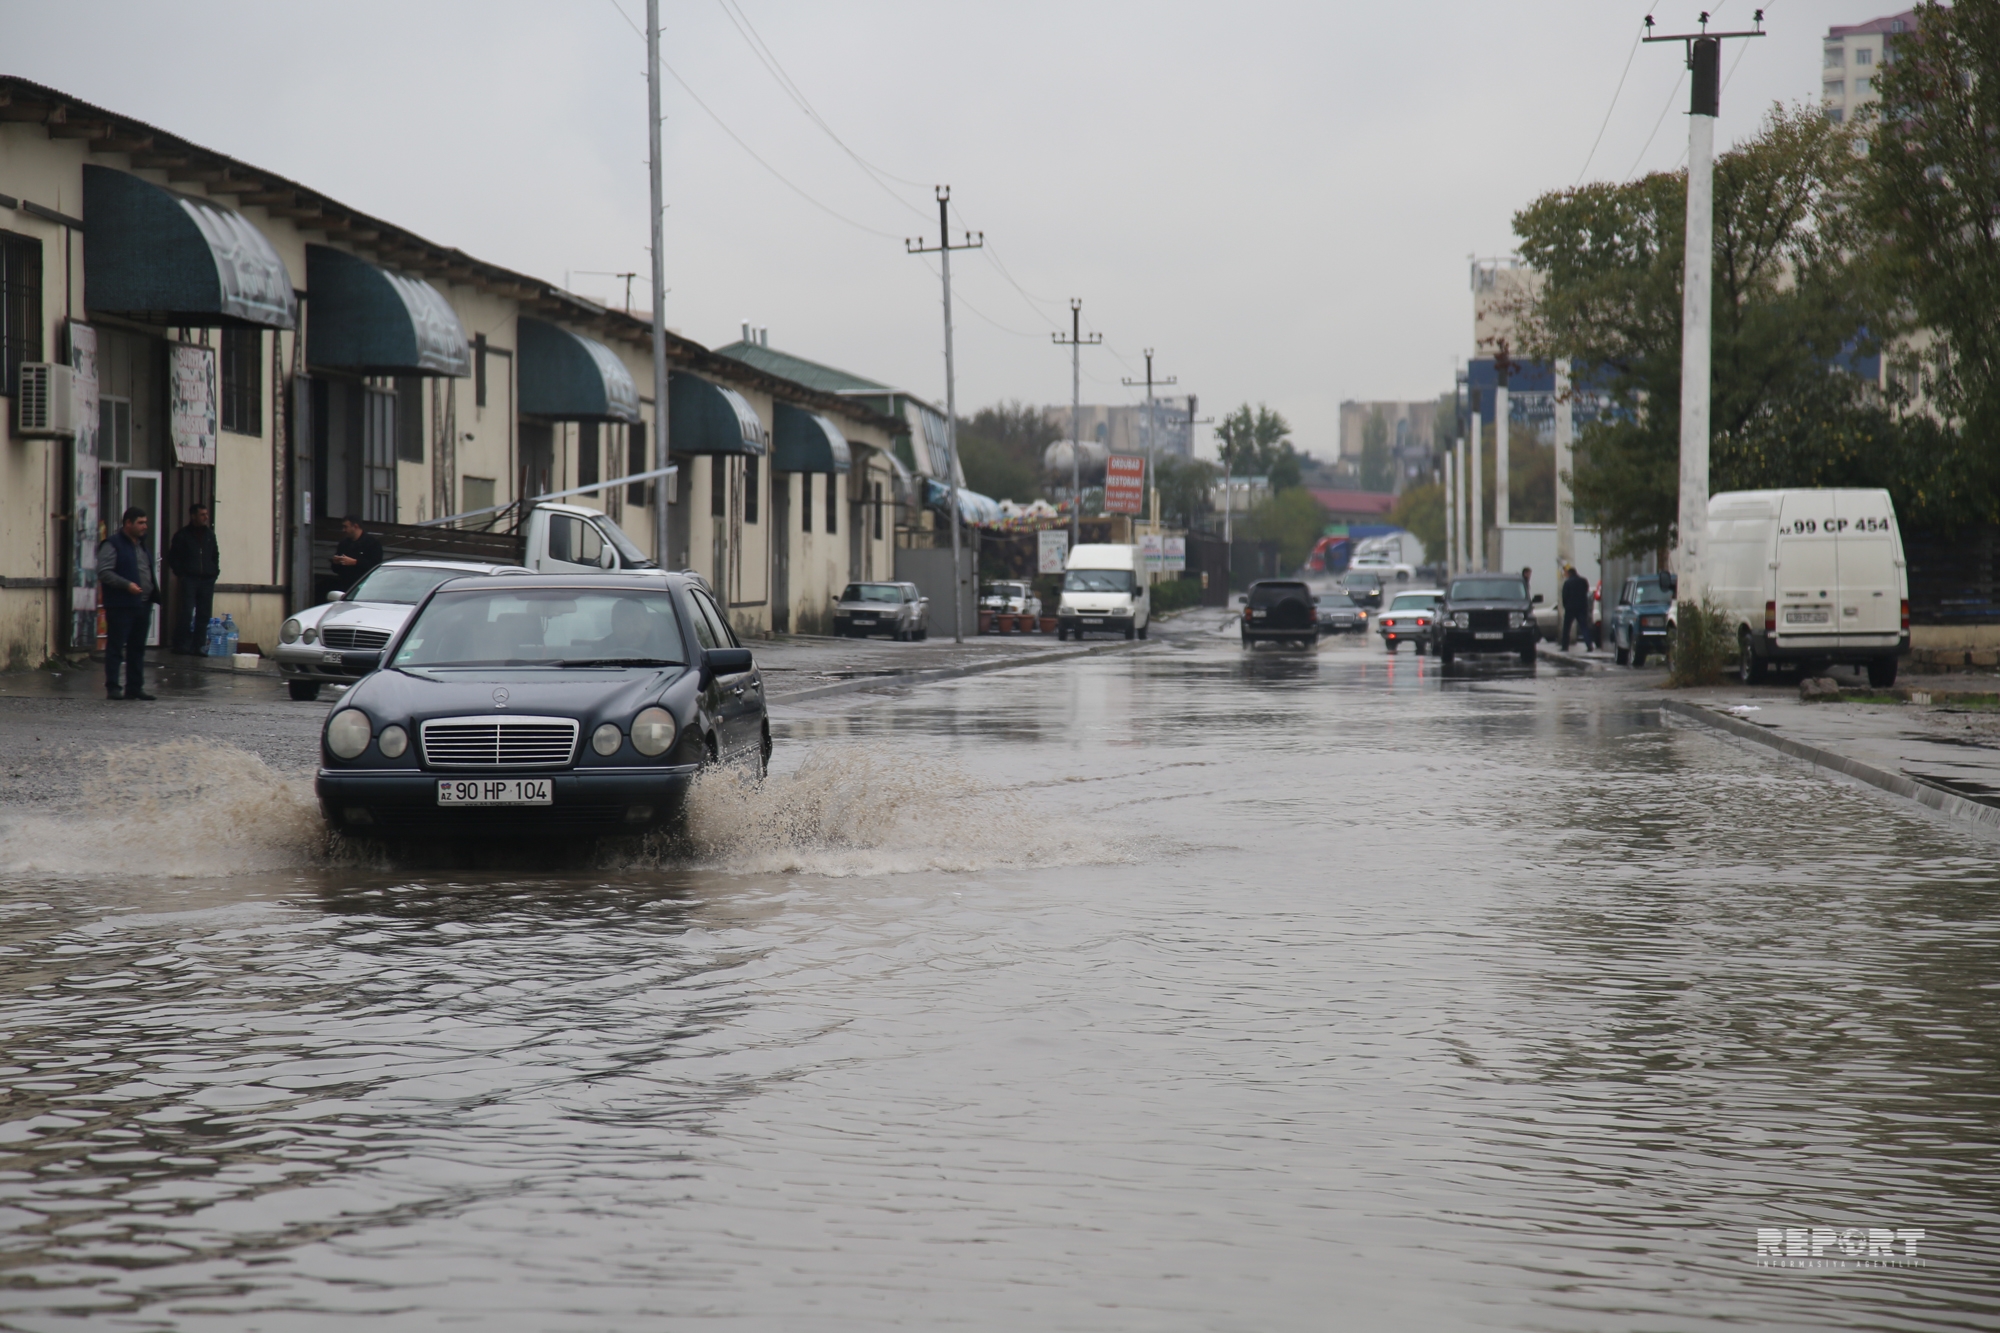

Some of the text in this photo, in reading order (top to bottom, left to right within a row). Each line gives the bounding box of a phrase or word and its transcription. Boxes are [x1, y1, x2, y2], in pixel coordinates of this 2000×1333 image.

[180, 414, 210, 435] MOSKVA
[1111, 458, 1140, 471] ORDUBAD
[1779, 516, 1889, 535] AZ 99 CP 454
[441, 781, 547, 801] AZ 90 HP 104
